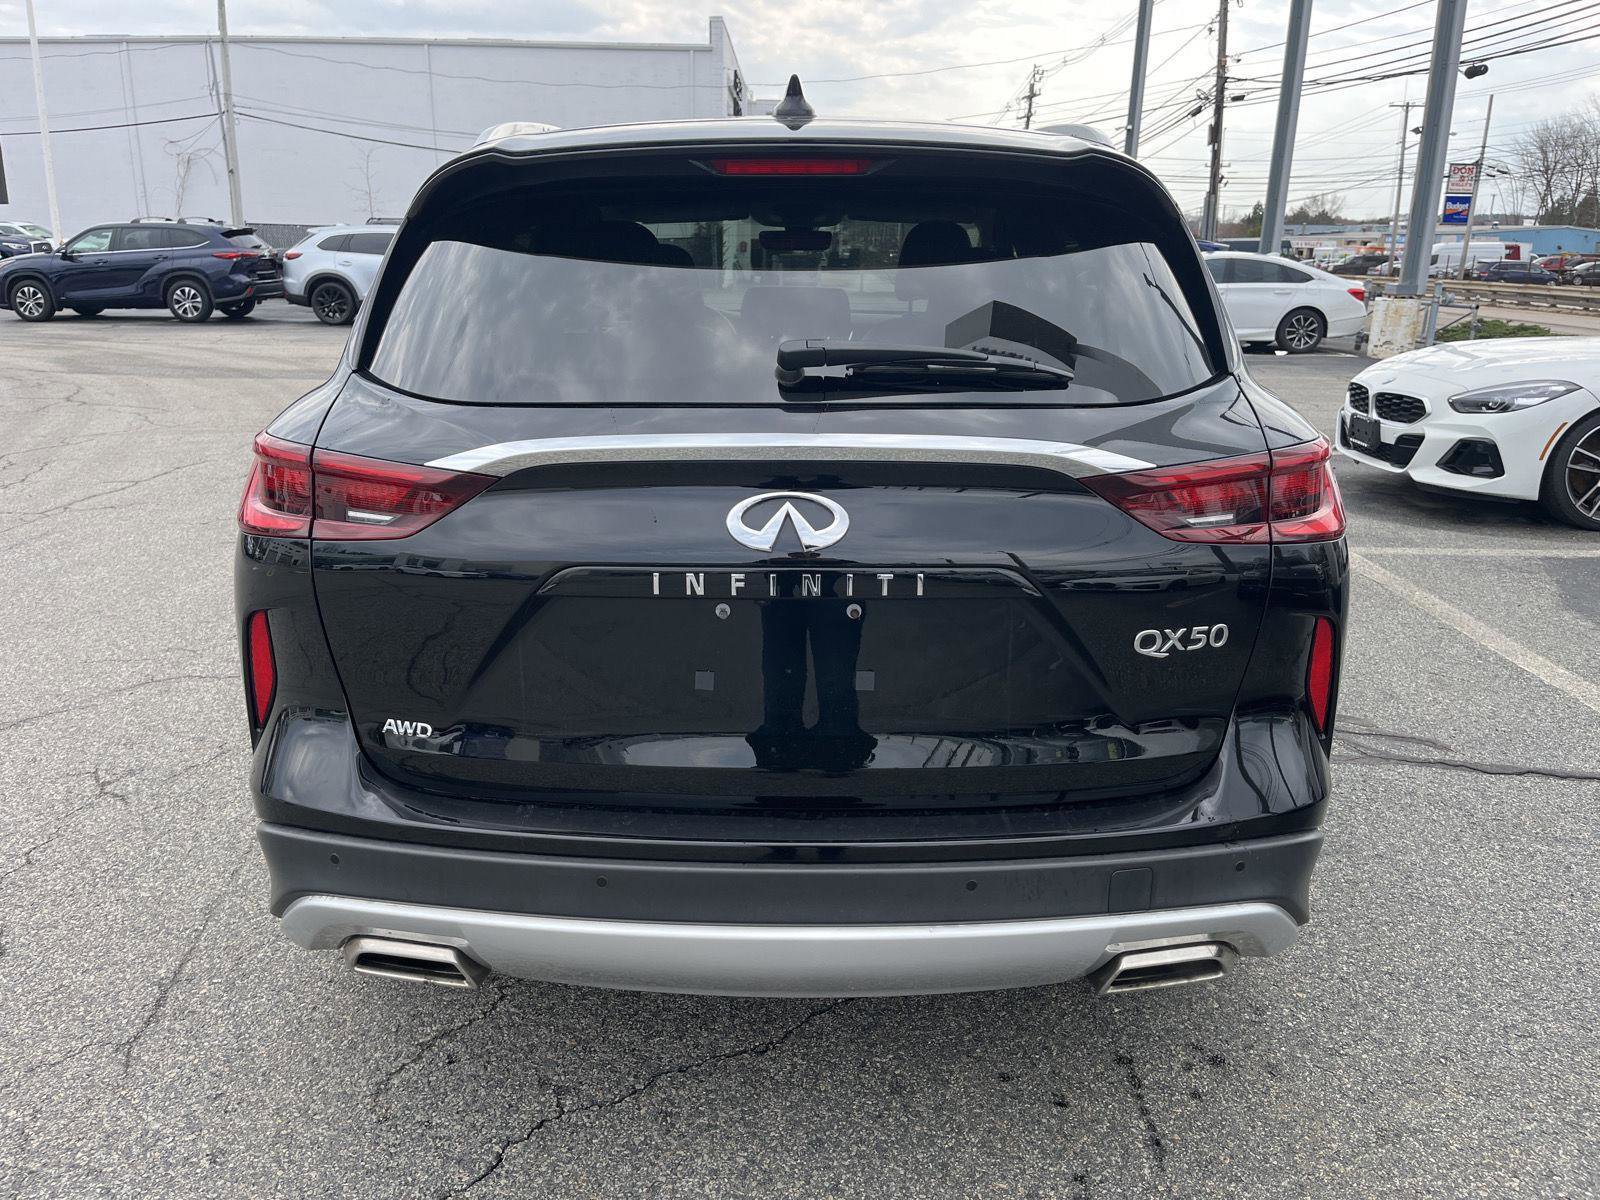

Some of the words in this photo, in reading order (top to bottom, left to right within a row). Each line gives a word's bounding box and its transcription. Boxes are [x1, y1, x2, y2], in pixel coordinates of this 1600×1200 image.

[1453, 167, 1474, 175] DON
[1447, 202, 1469, 211] Budget
[652, 572, 924, 597] INFINITI
[1133, 623, 1229, 658] QX50
[381, 718, 433, 738] AWD
